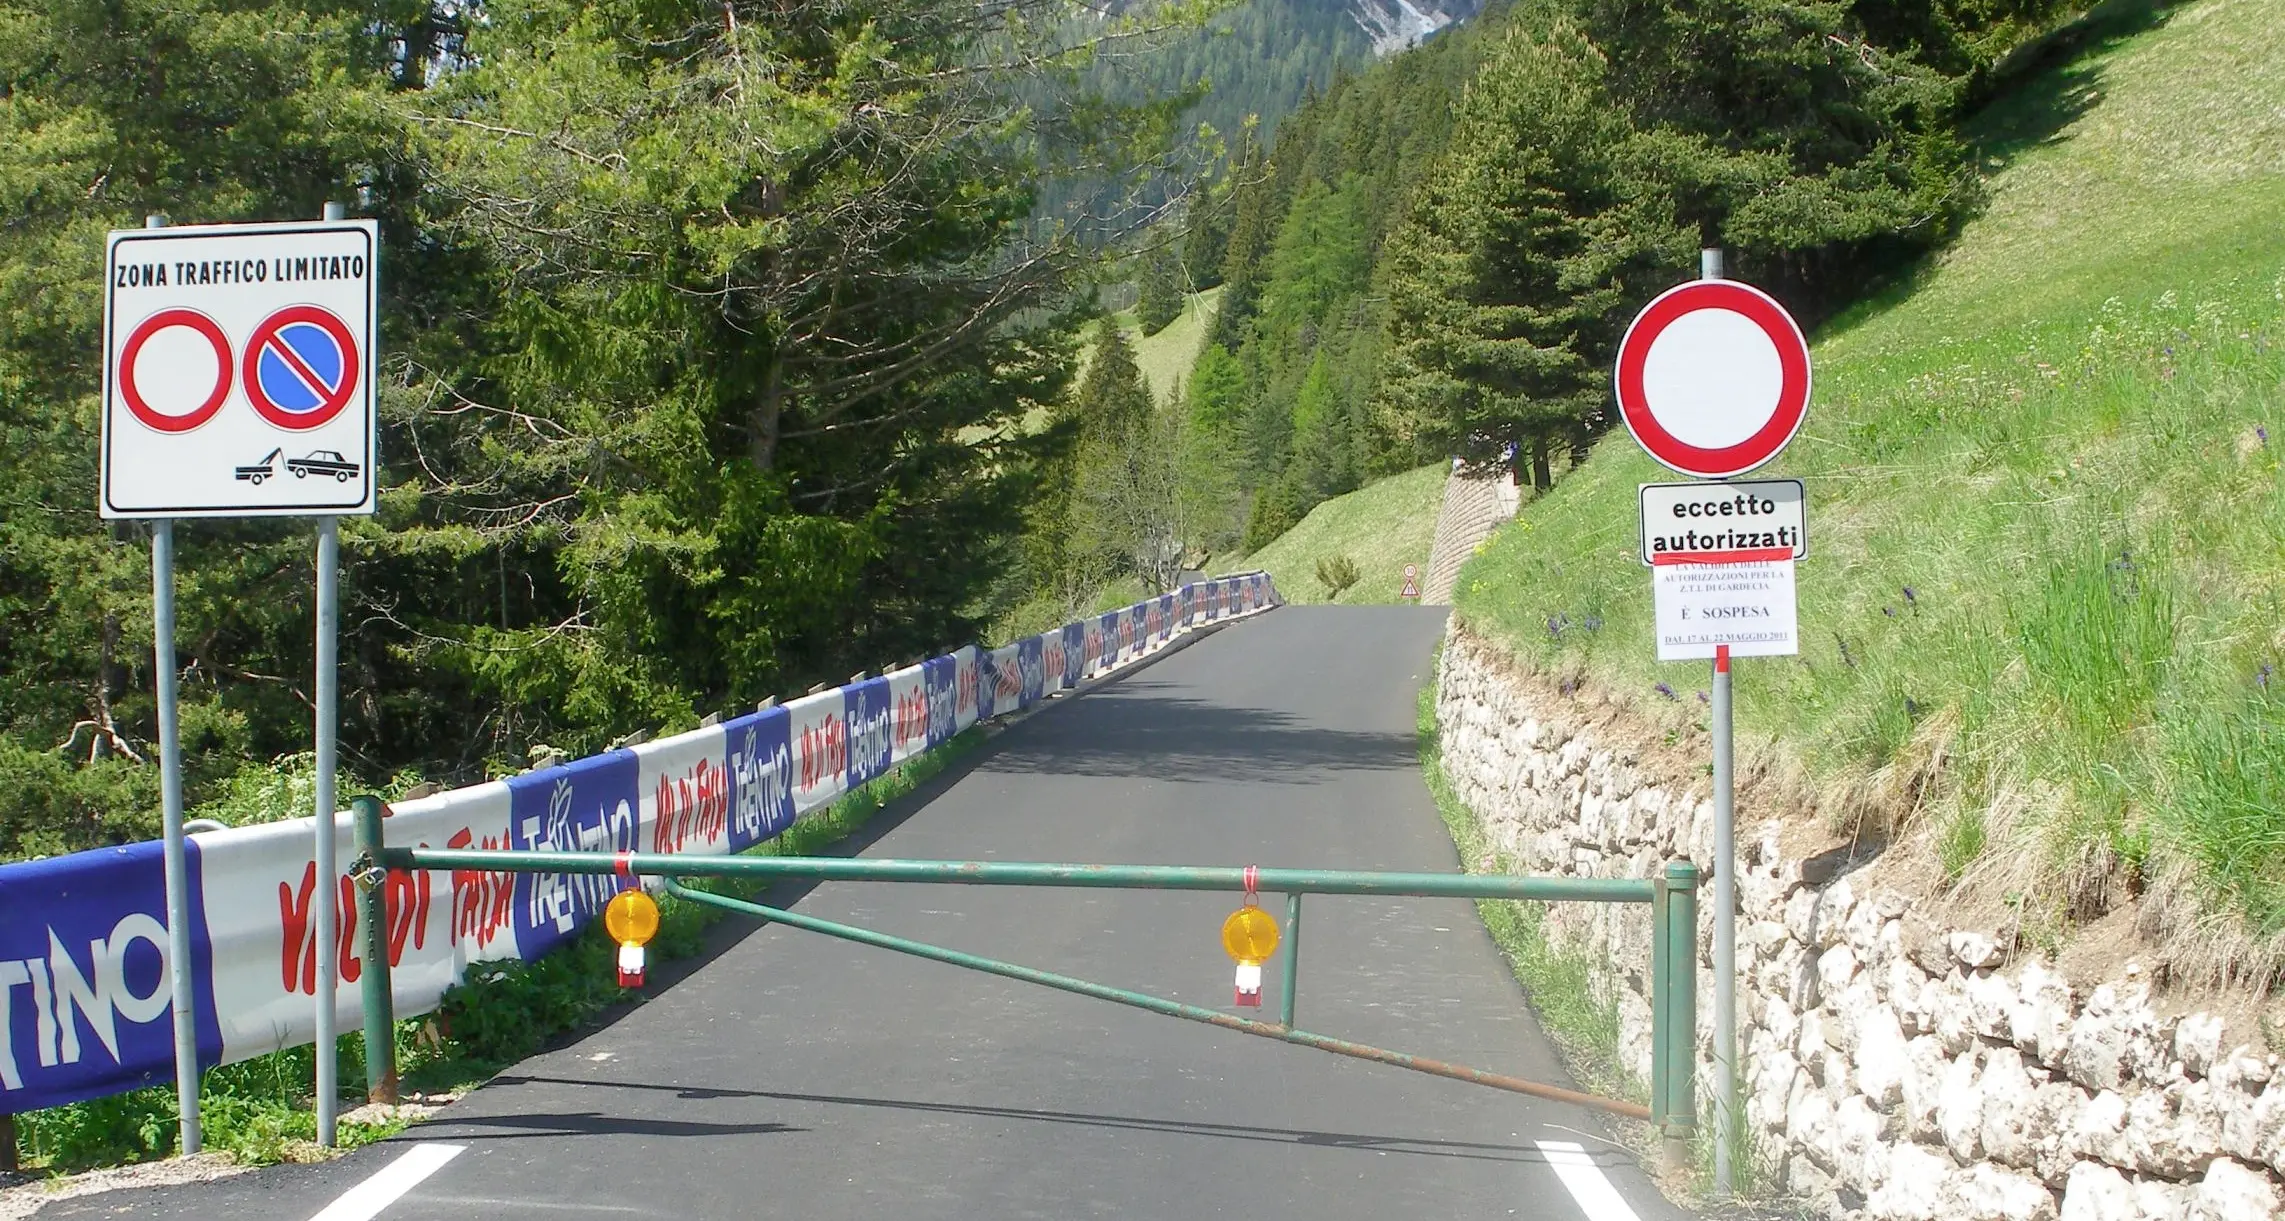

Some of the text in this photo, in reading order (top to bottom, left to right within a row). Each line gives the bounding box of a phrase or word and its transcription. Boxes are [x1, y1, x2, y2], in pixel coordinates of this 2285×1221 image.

[117, 255, 364, 288] ZONA TRAFFICO LIMITATO
[1673, 494, 1775, 518] eccetto
[1653, 526, 1797, 552] autorizzati
[1664, 571, 1784, 583] AUTORIZZAZIONI PER LA
[1705, 583, 1716, 592] DI
[1718, 582, 1770, 592] GARDECIA
[1680, 604, 1770, 620] È SOSPESA
[1665, 634, 1685, 644] DAL
[1687, 634, 1697, 643] 17
[1700, 634, 1712, 642] AL
[1714, 633, 1724, 642] 22
[1726, 632, 1767, 641] MAGGIO
[732, 742, 790, 841] TRENTINO
[653, 757, 728, 854] VAL DI FASSA
[522, 799, 632, 934] TRENTINO
[447, 826, 514, 950] FASSA
